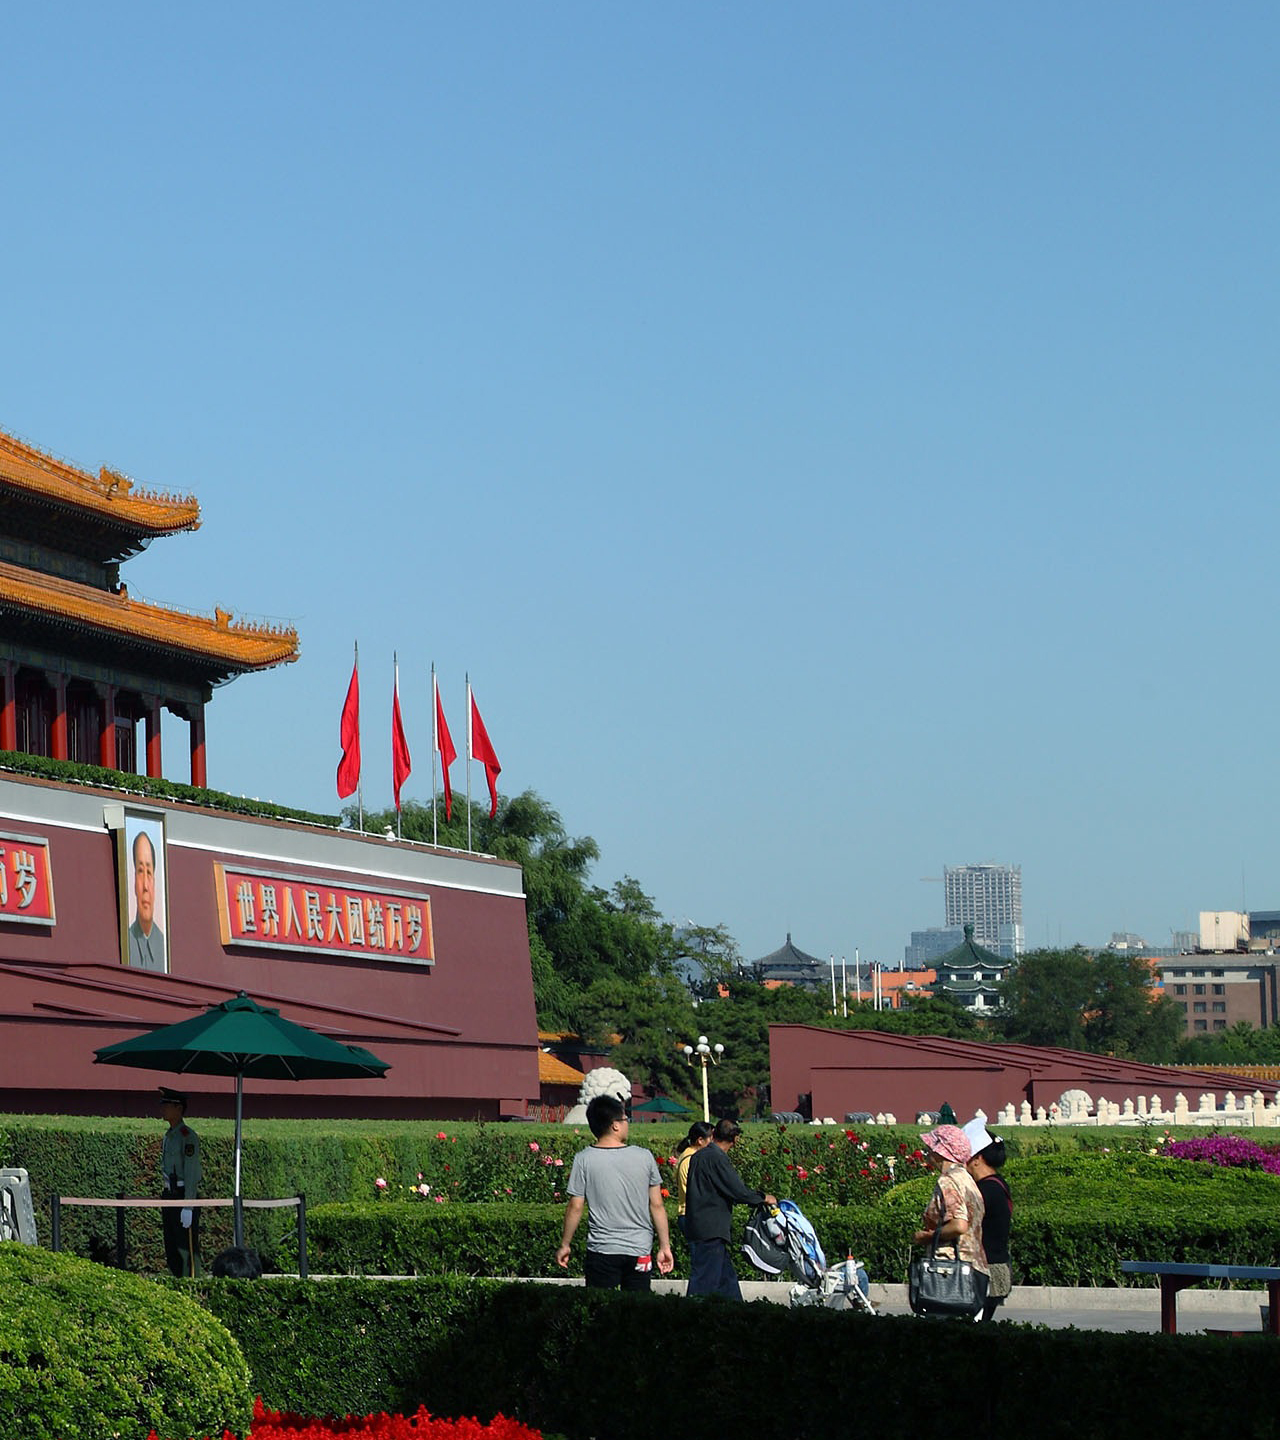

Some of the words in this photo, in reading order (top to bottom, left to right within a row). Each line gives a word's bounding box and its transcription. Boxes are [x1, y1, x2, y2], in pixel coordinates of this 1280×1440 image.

[237, 880, 422, 952] 世界人民大团结万岁
